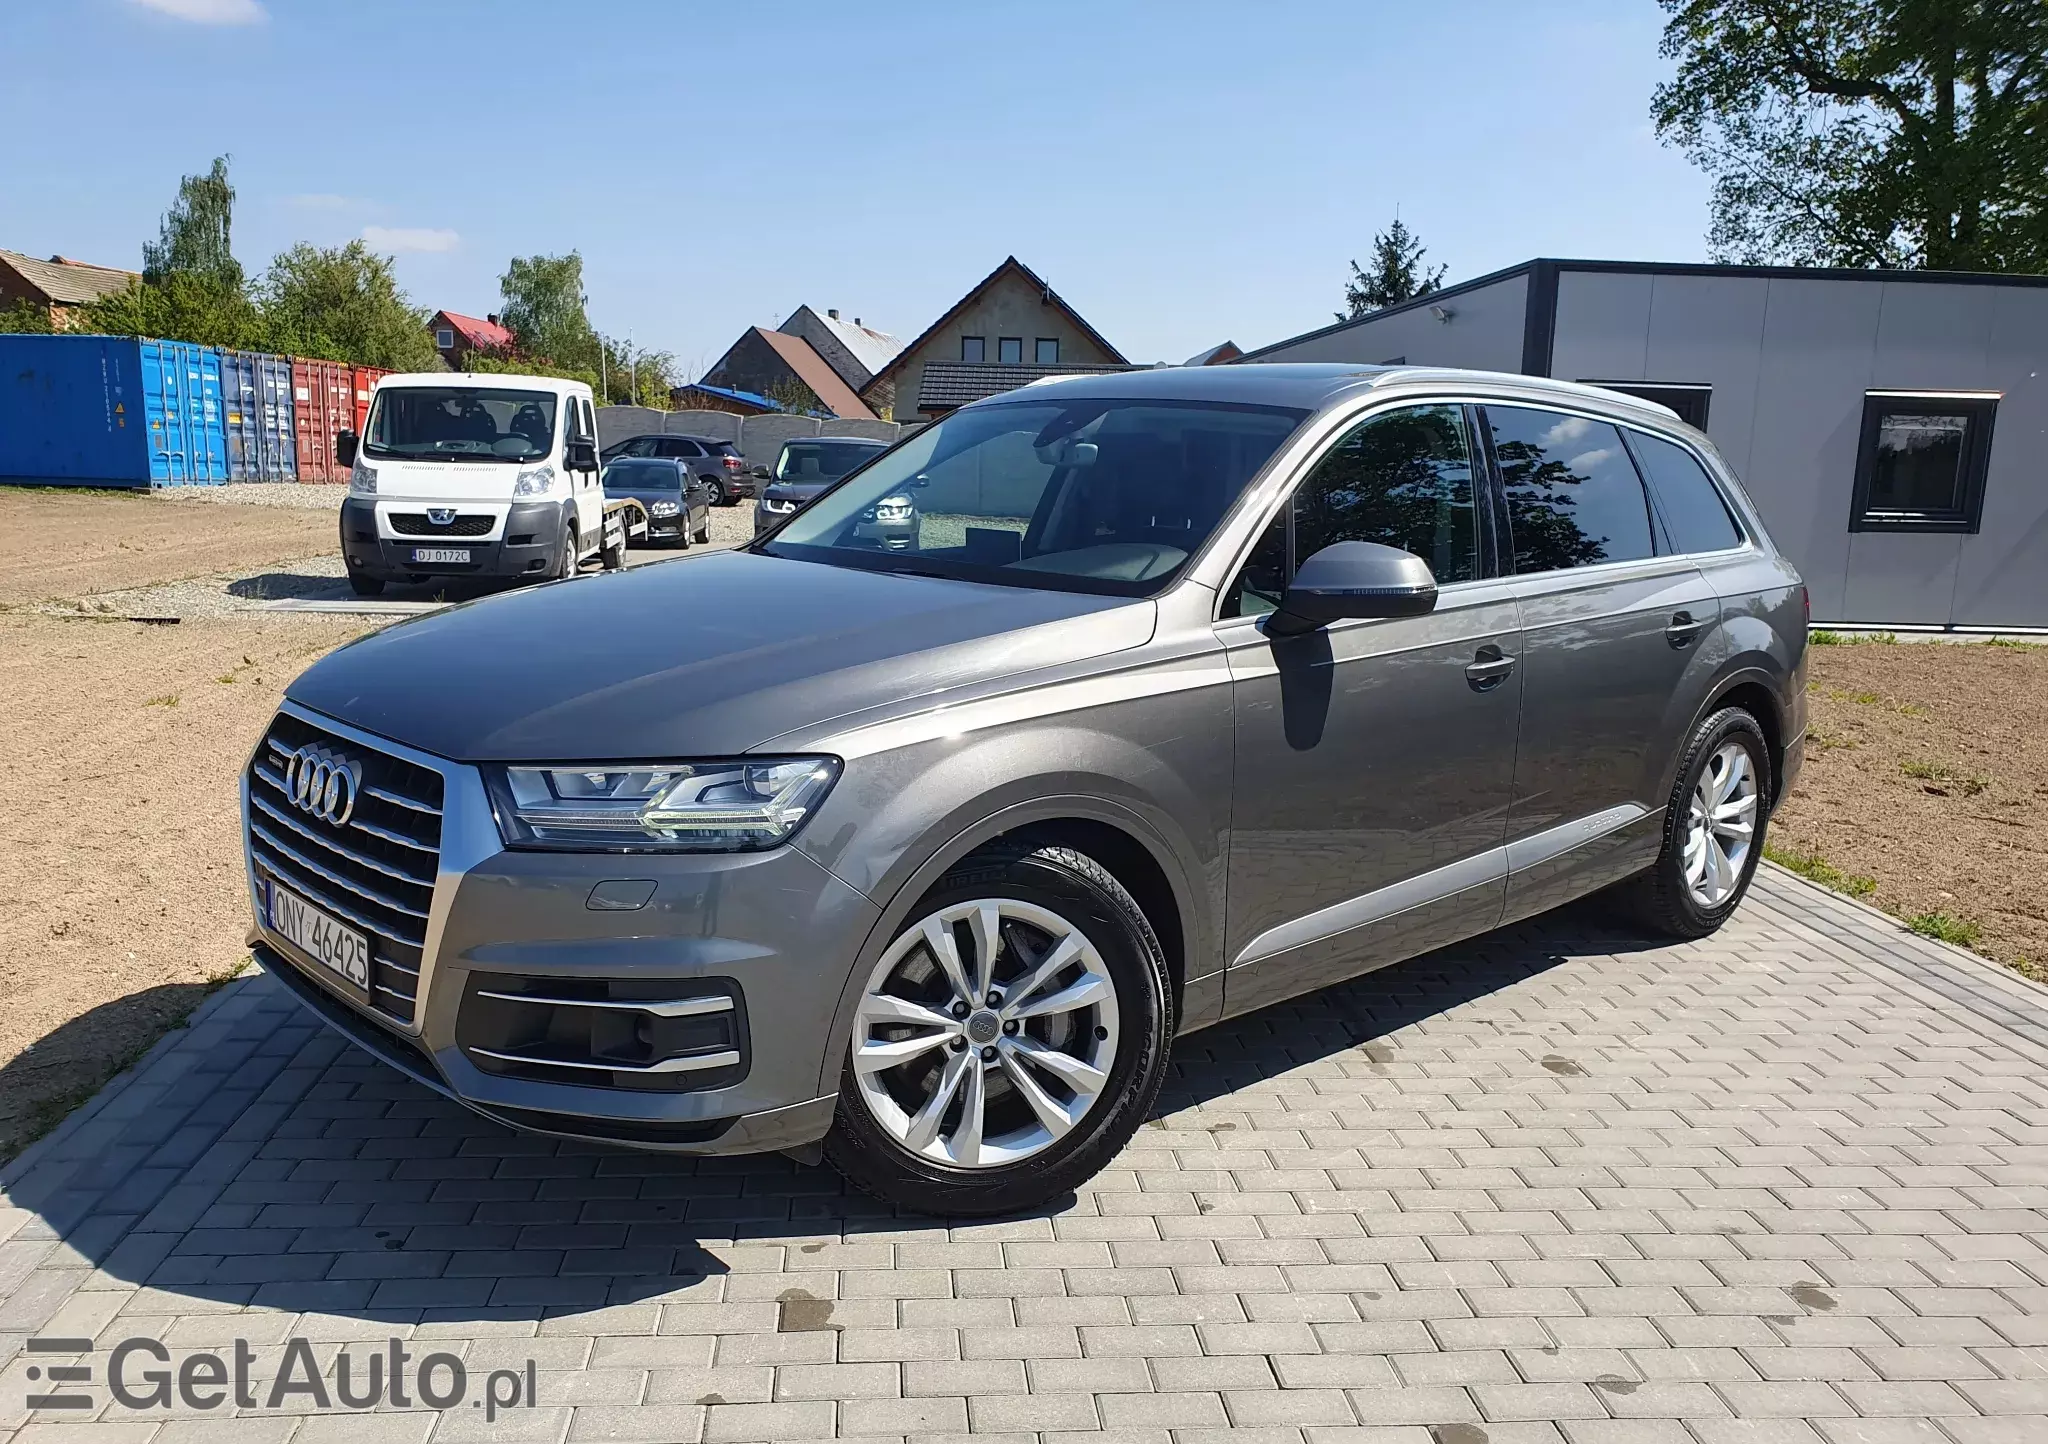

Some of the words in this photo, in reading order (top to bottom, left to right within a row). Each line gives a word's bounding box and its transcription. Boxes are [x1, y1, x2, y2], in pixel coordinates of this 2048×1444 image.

[418, 550, 431, 561] DJ
[435, 550, 467, 561] 0172C
[276, 891, 305, 946] ONY
[311, 915, 368, 985] 46425
